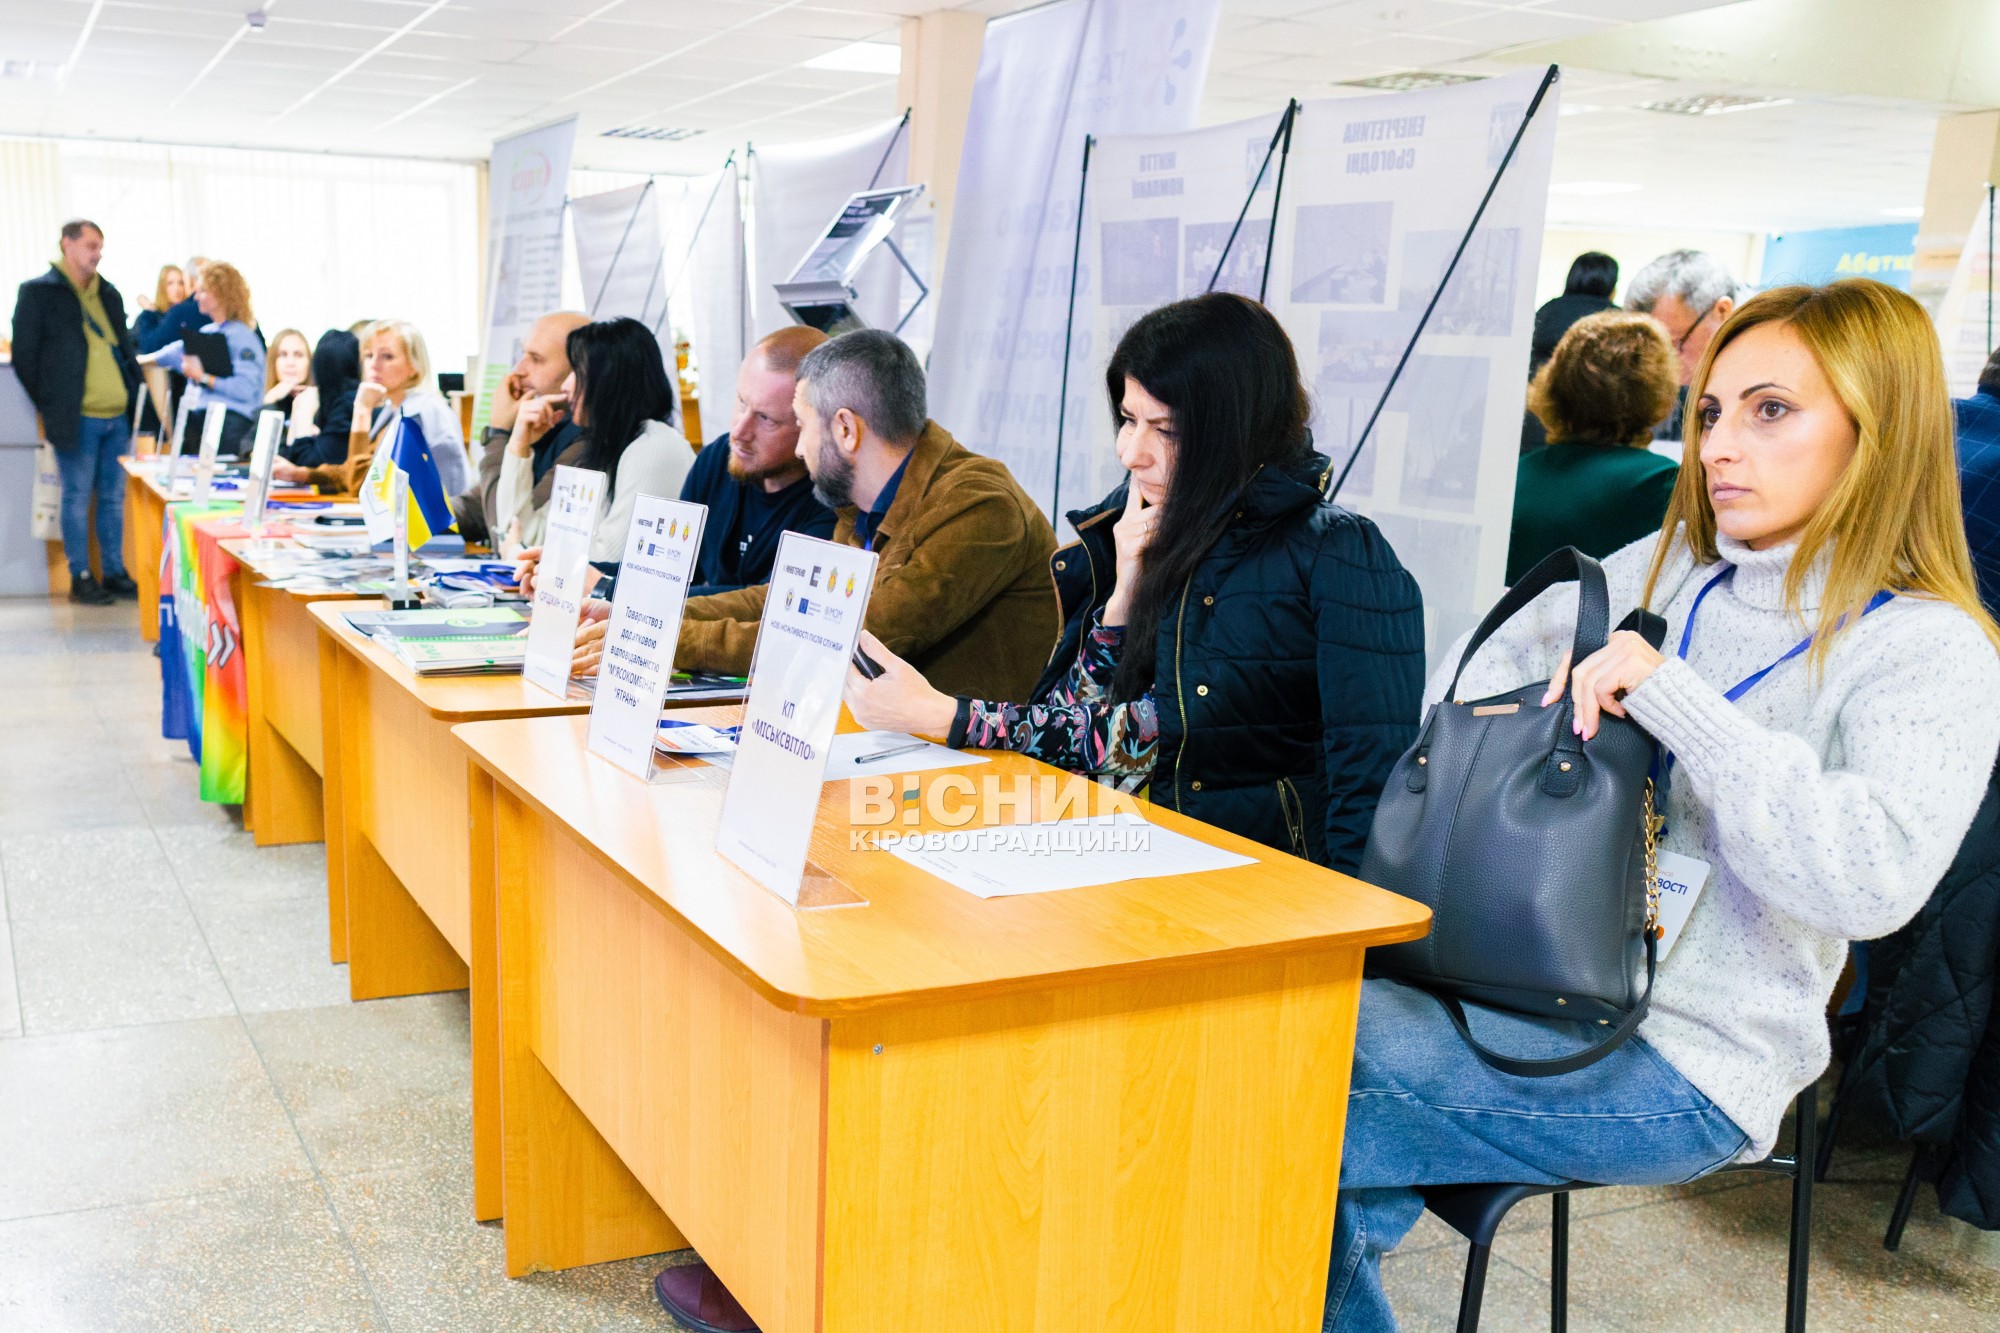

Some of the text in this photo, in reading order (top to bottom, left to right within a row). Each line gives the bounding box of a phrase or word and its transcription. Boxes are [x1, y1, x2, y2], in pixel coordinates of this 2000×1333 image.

[625, 607, 658, 627] Товариство
[620, 628, 656, 648] додатковою
[781, 700, 796, 720] КП
[751, 718, 816, 761] «МІСЬКСВІТЛО»
